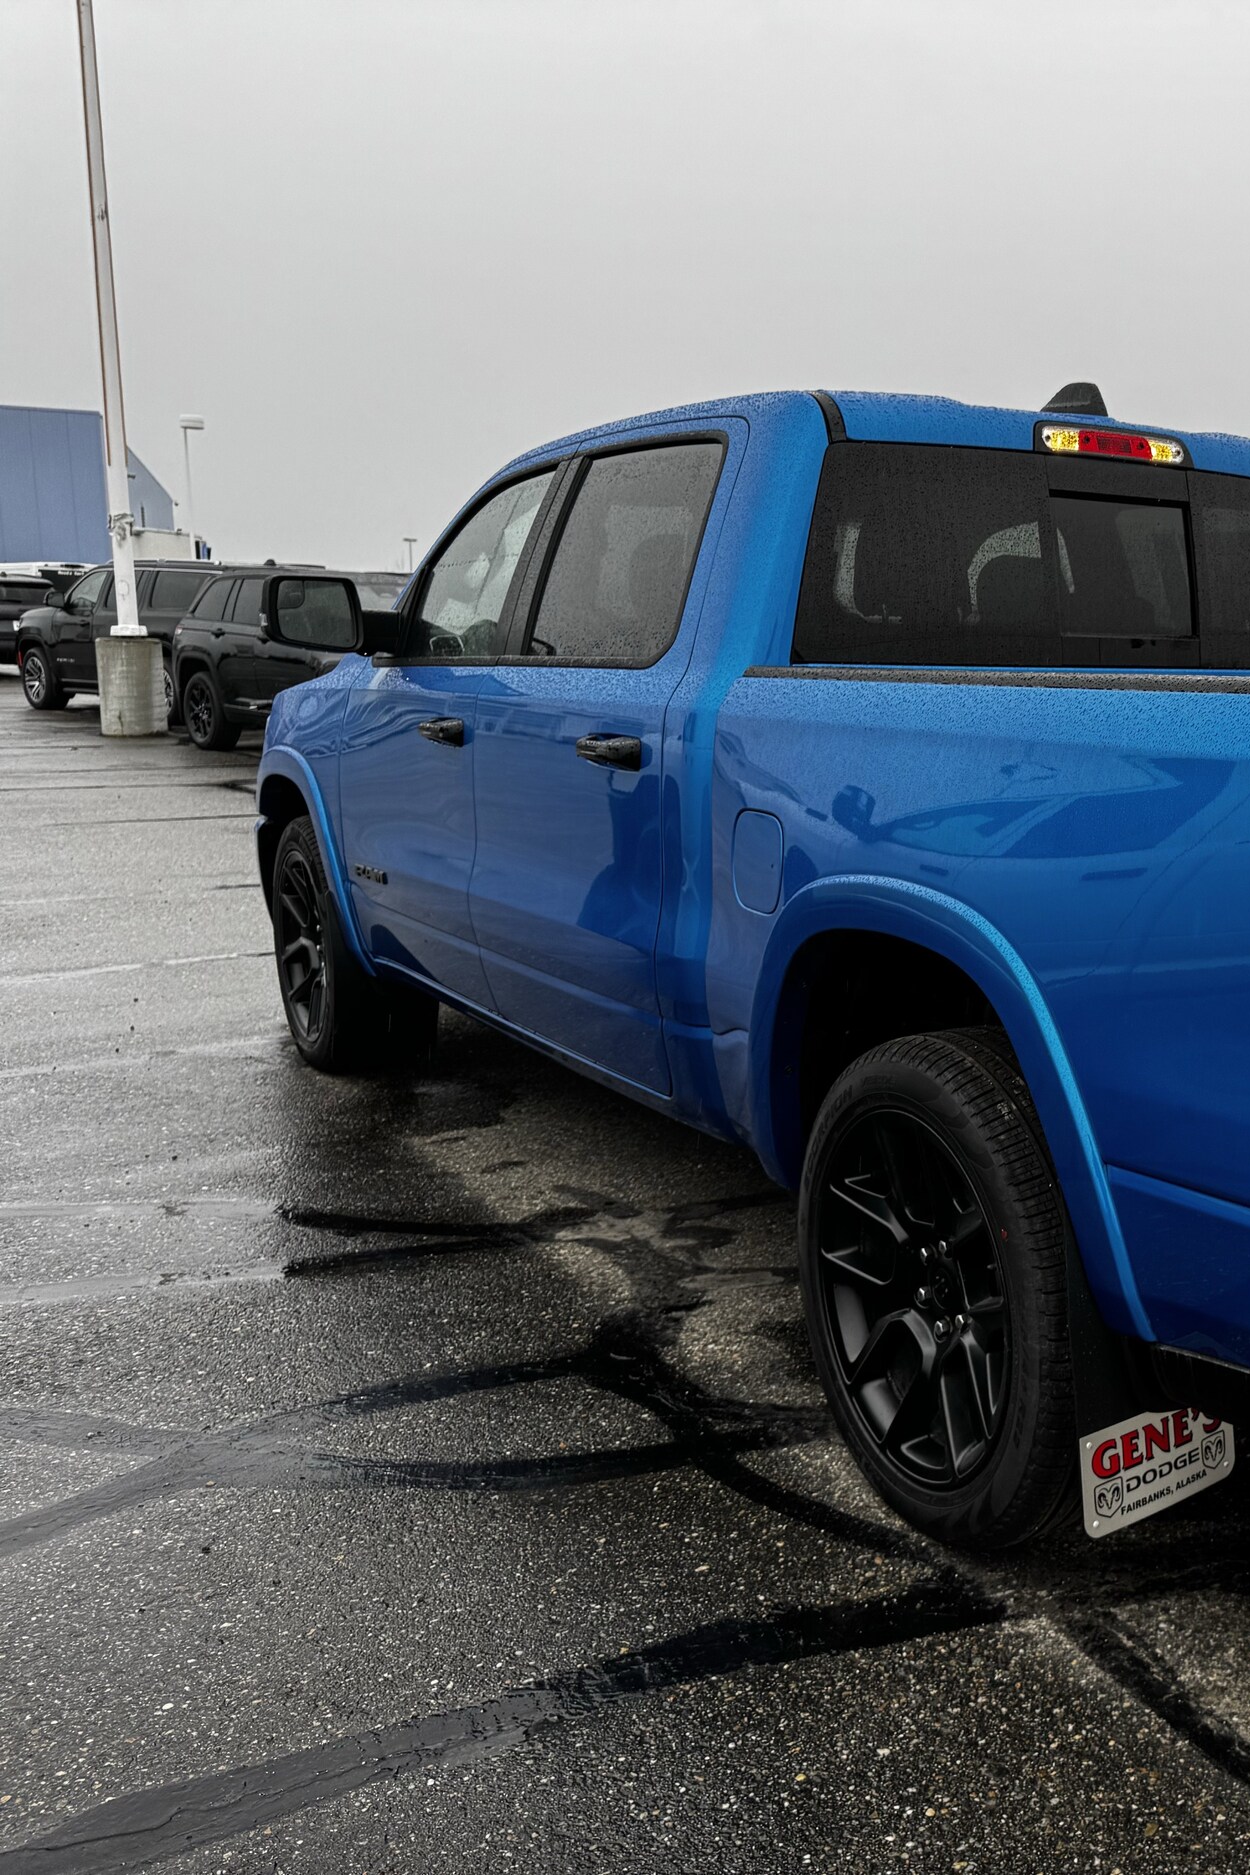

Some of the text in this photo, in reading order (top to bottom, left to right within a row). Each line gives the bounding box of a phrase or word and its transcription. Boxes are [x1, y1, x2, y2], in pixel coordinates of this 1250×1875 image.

[1120, 1469, 1208, 1516] FAIRBANKS, ALASKA
[1126, 1447, 1201, 1493] DODGE
